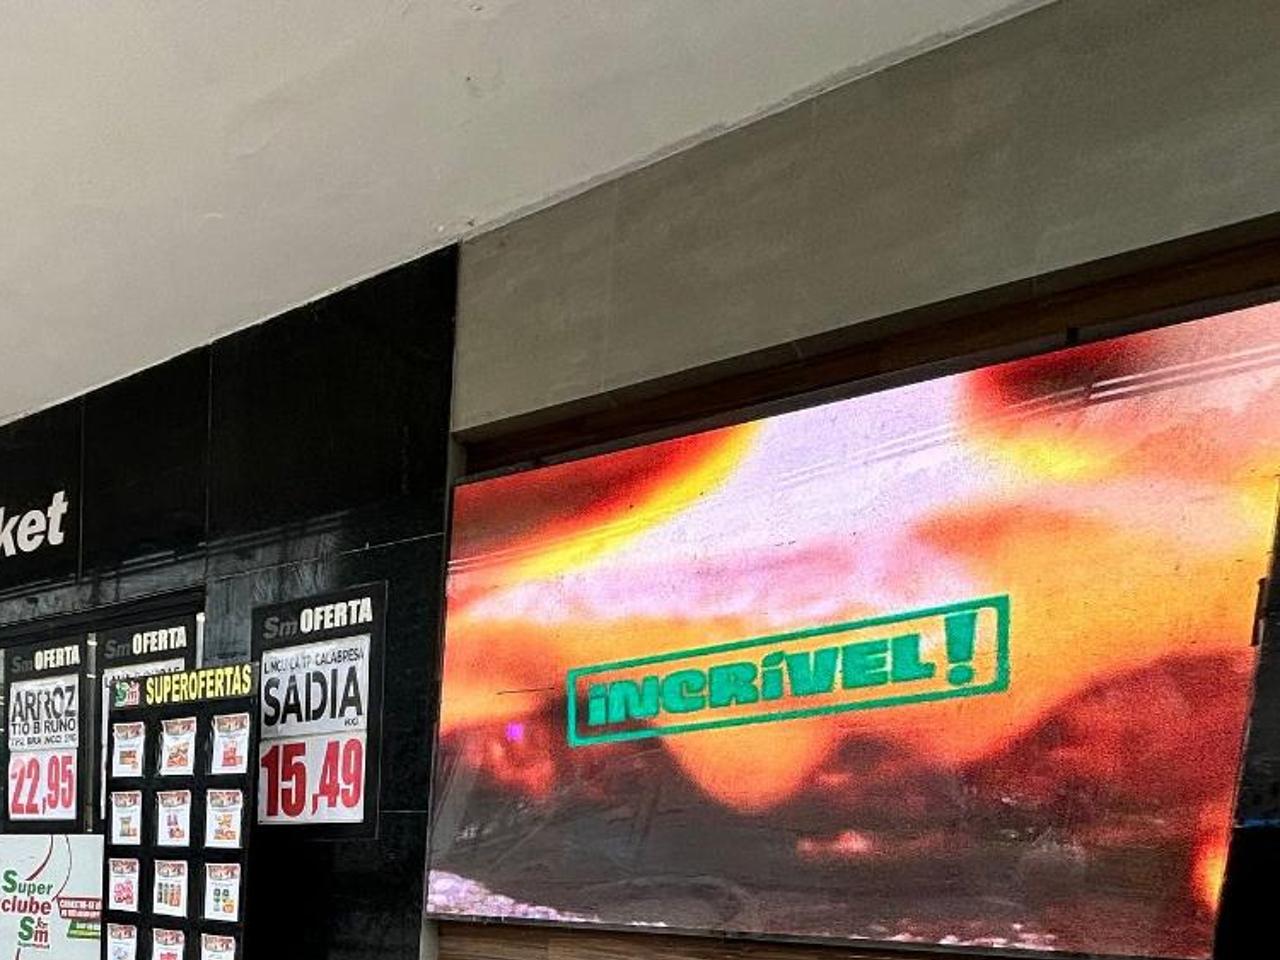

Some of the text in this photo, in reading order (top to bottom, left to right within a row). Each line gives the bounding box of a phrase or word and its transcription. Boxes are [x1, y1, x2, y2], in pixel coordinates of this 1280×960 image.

[300, 597, 373, 634] OFERTA
[34, 644, 80, 671] OFERTA
[132, 626, 187, 655] OFERTA
[146, 664, 252, 705] SUPEROFERTAS
[263, 665, 363, 727] SADIA
[11, 685, 76, 722] ARROZ
[10, 755, 74, 816] 22,95
[260, 738, 363, 818] 15,49
[1, 869, 54, 897] Super
[1, 896, 52, 915] clube
[18, 916, 49, 943] Sm
